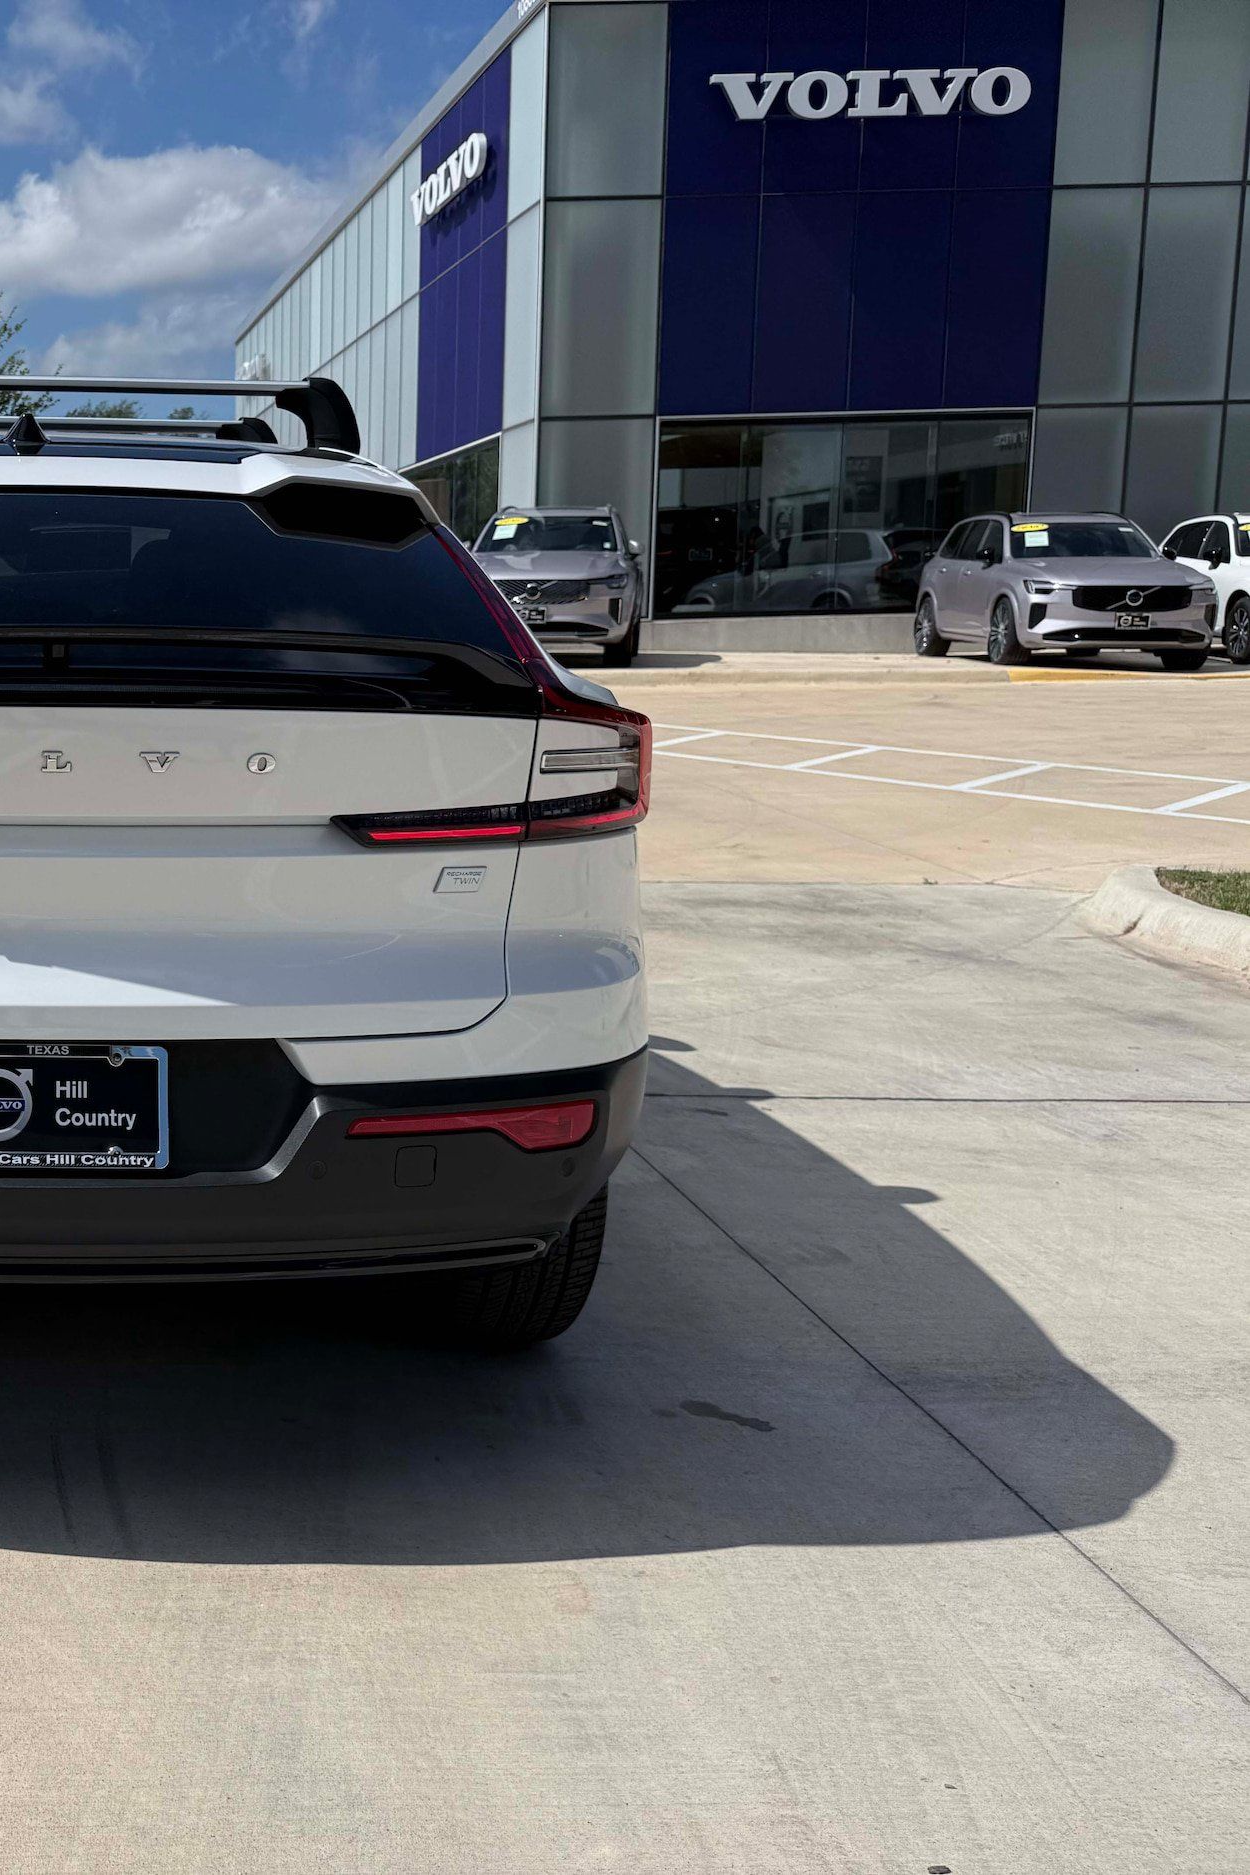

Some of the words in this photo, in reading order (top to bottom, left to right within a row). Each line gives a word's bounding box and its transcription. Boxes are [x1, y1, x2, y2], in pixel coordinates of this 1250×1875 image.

[709, 66, 1032, 120] VOLVO
[411, 132, 487, 226] VOLVO
[453, 877, 480, 885] TWIN
[26, 1045, 70, 1055] TEXAS
[55, 1080, 88, 1099] Hill
[55, 1107, 137, 1131] Country
[46, 1153, 76, 1166] Hill
[80, 1153, 155, 1168] Country
